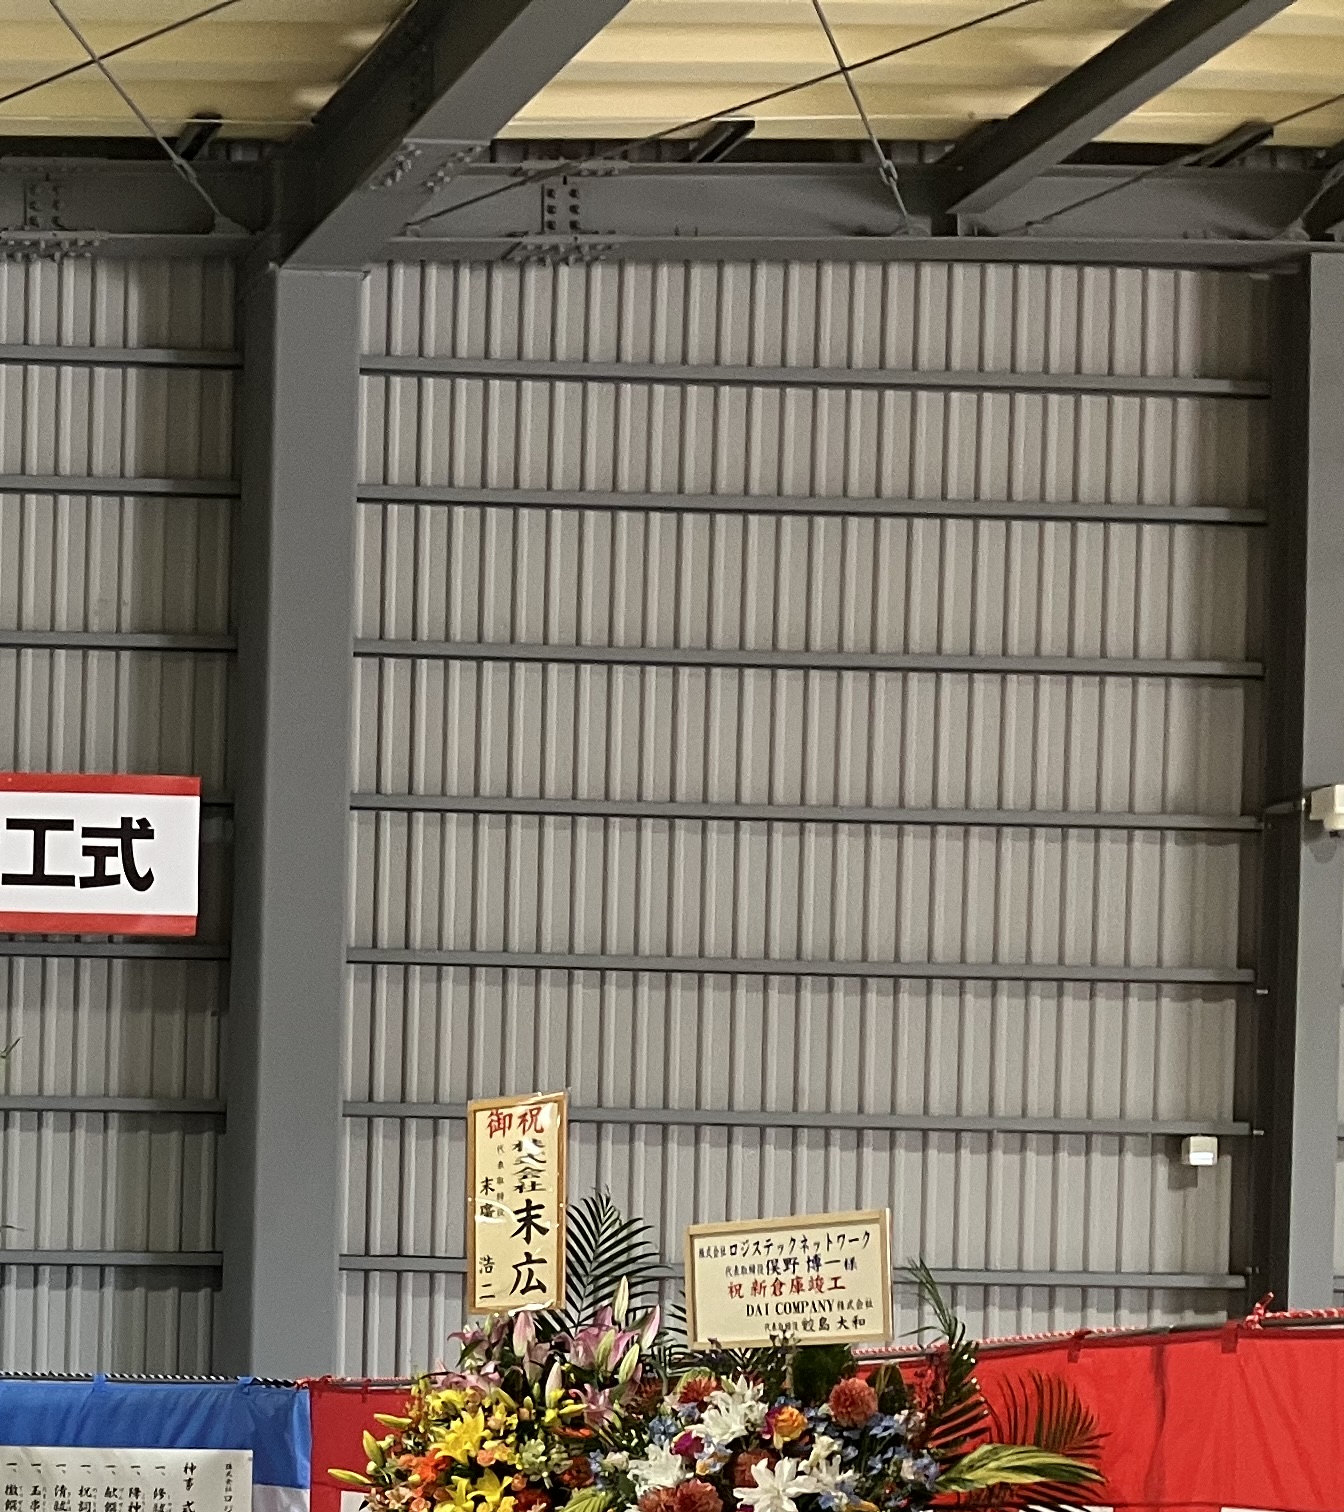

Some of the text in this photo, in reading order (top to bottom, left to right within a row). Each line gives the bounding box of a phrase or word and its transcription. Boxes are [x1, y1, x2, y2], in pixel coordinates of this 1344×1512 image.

[487, 1107, 545, 1139] 御祝
[699, 1231, 871, 1258] 株式会社ロジステックネットワーク
[746, 1303, 769, 1317] DAI
